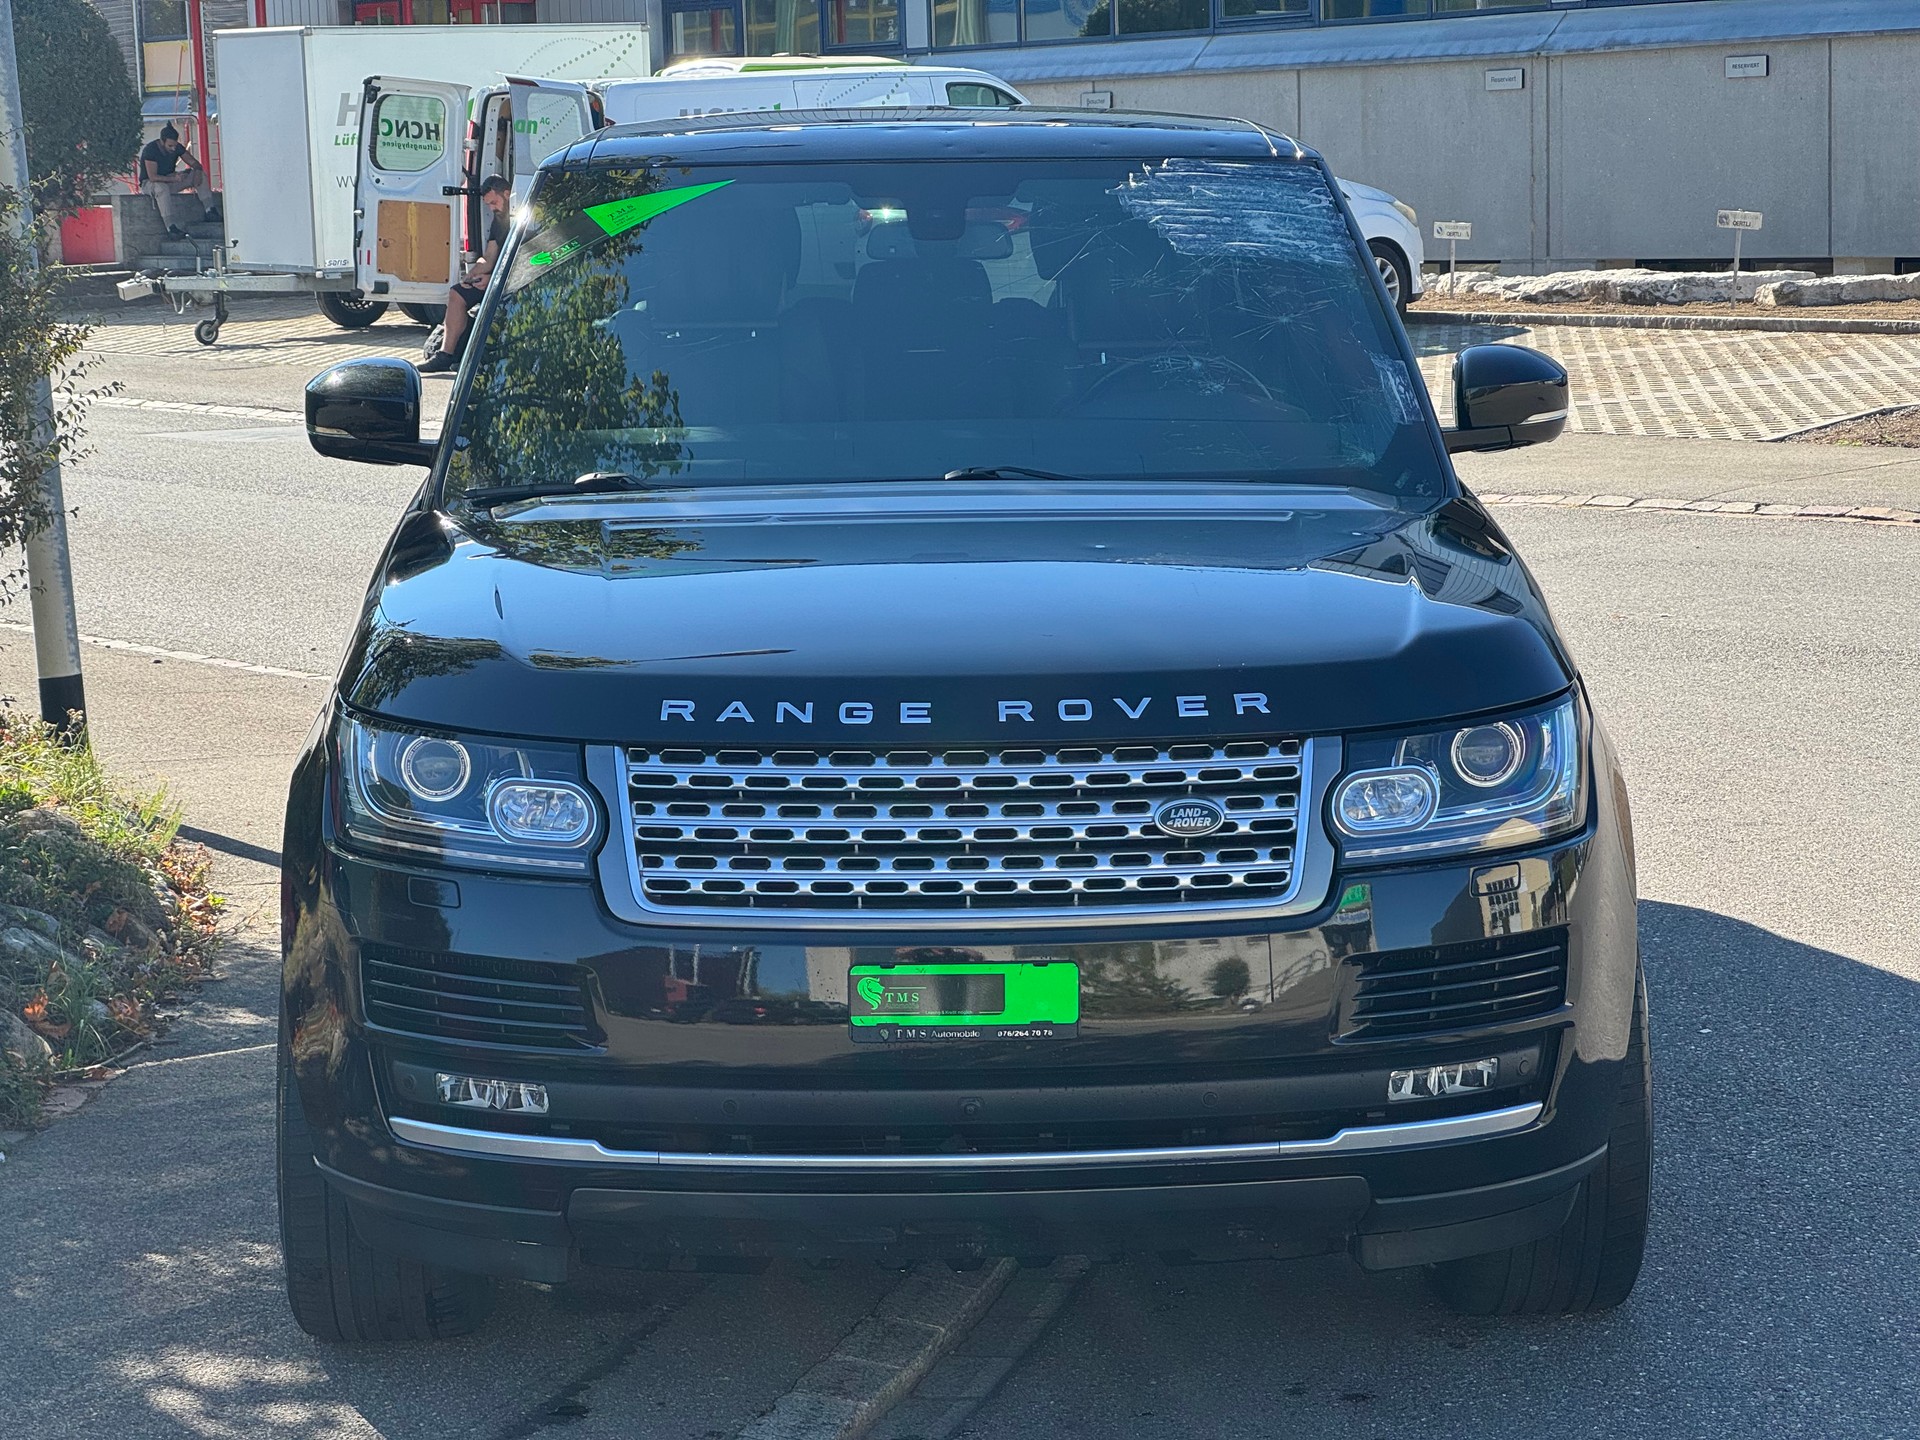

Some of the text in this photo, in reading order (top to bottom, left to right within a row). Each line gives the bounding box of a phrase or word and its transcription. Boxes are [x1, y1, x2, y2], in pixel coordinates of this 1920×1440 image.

[1731, 62, 1760, 70] RESERVIERT
[539, 117, 550, 125] AG
[333, 133, 360, 146] Lüf
[659, 692, 1271, 725] RANGE ROVER
[1170, 807, 1201, 818] LAND
[1173, 817, 1211, 828] ROVER
[884, 992, 920, 1003] TMS
[895, 1029, 927, 1039] TMS
[931, 1030, 980, 1038] Automobile
